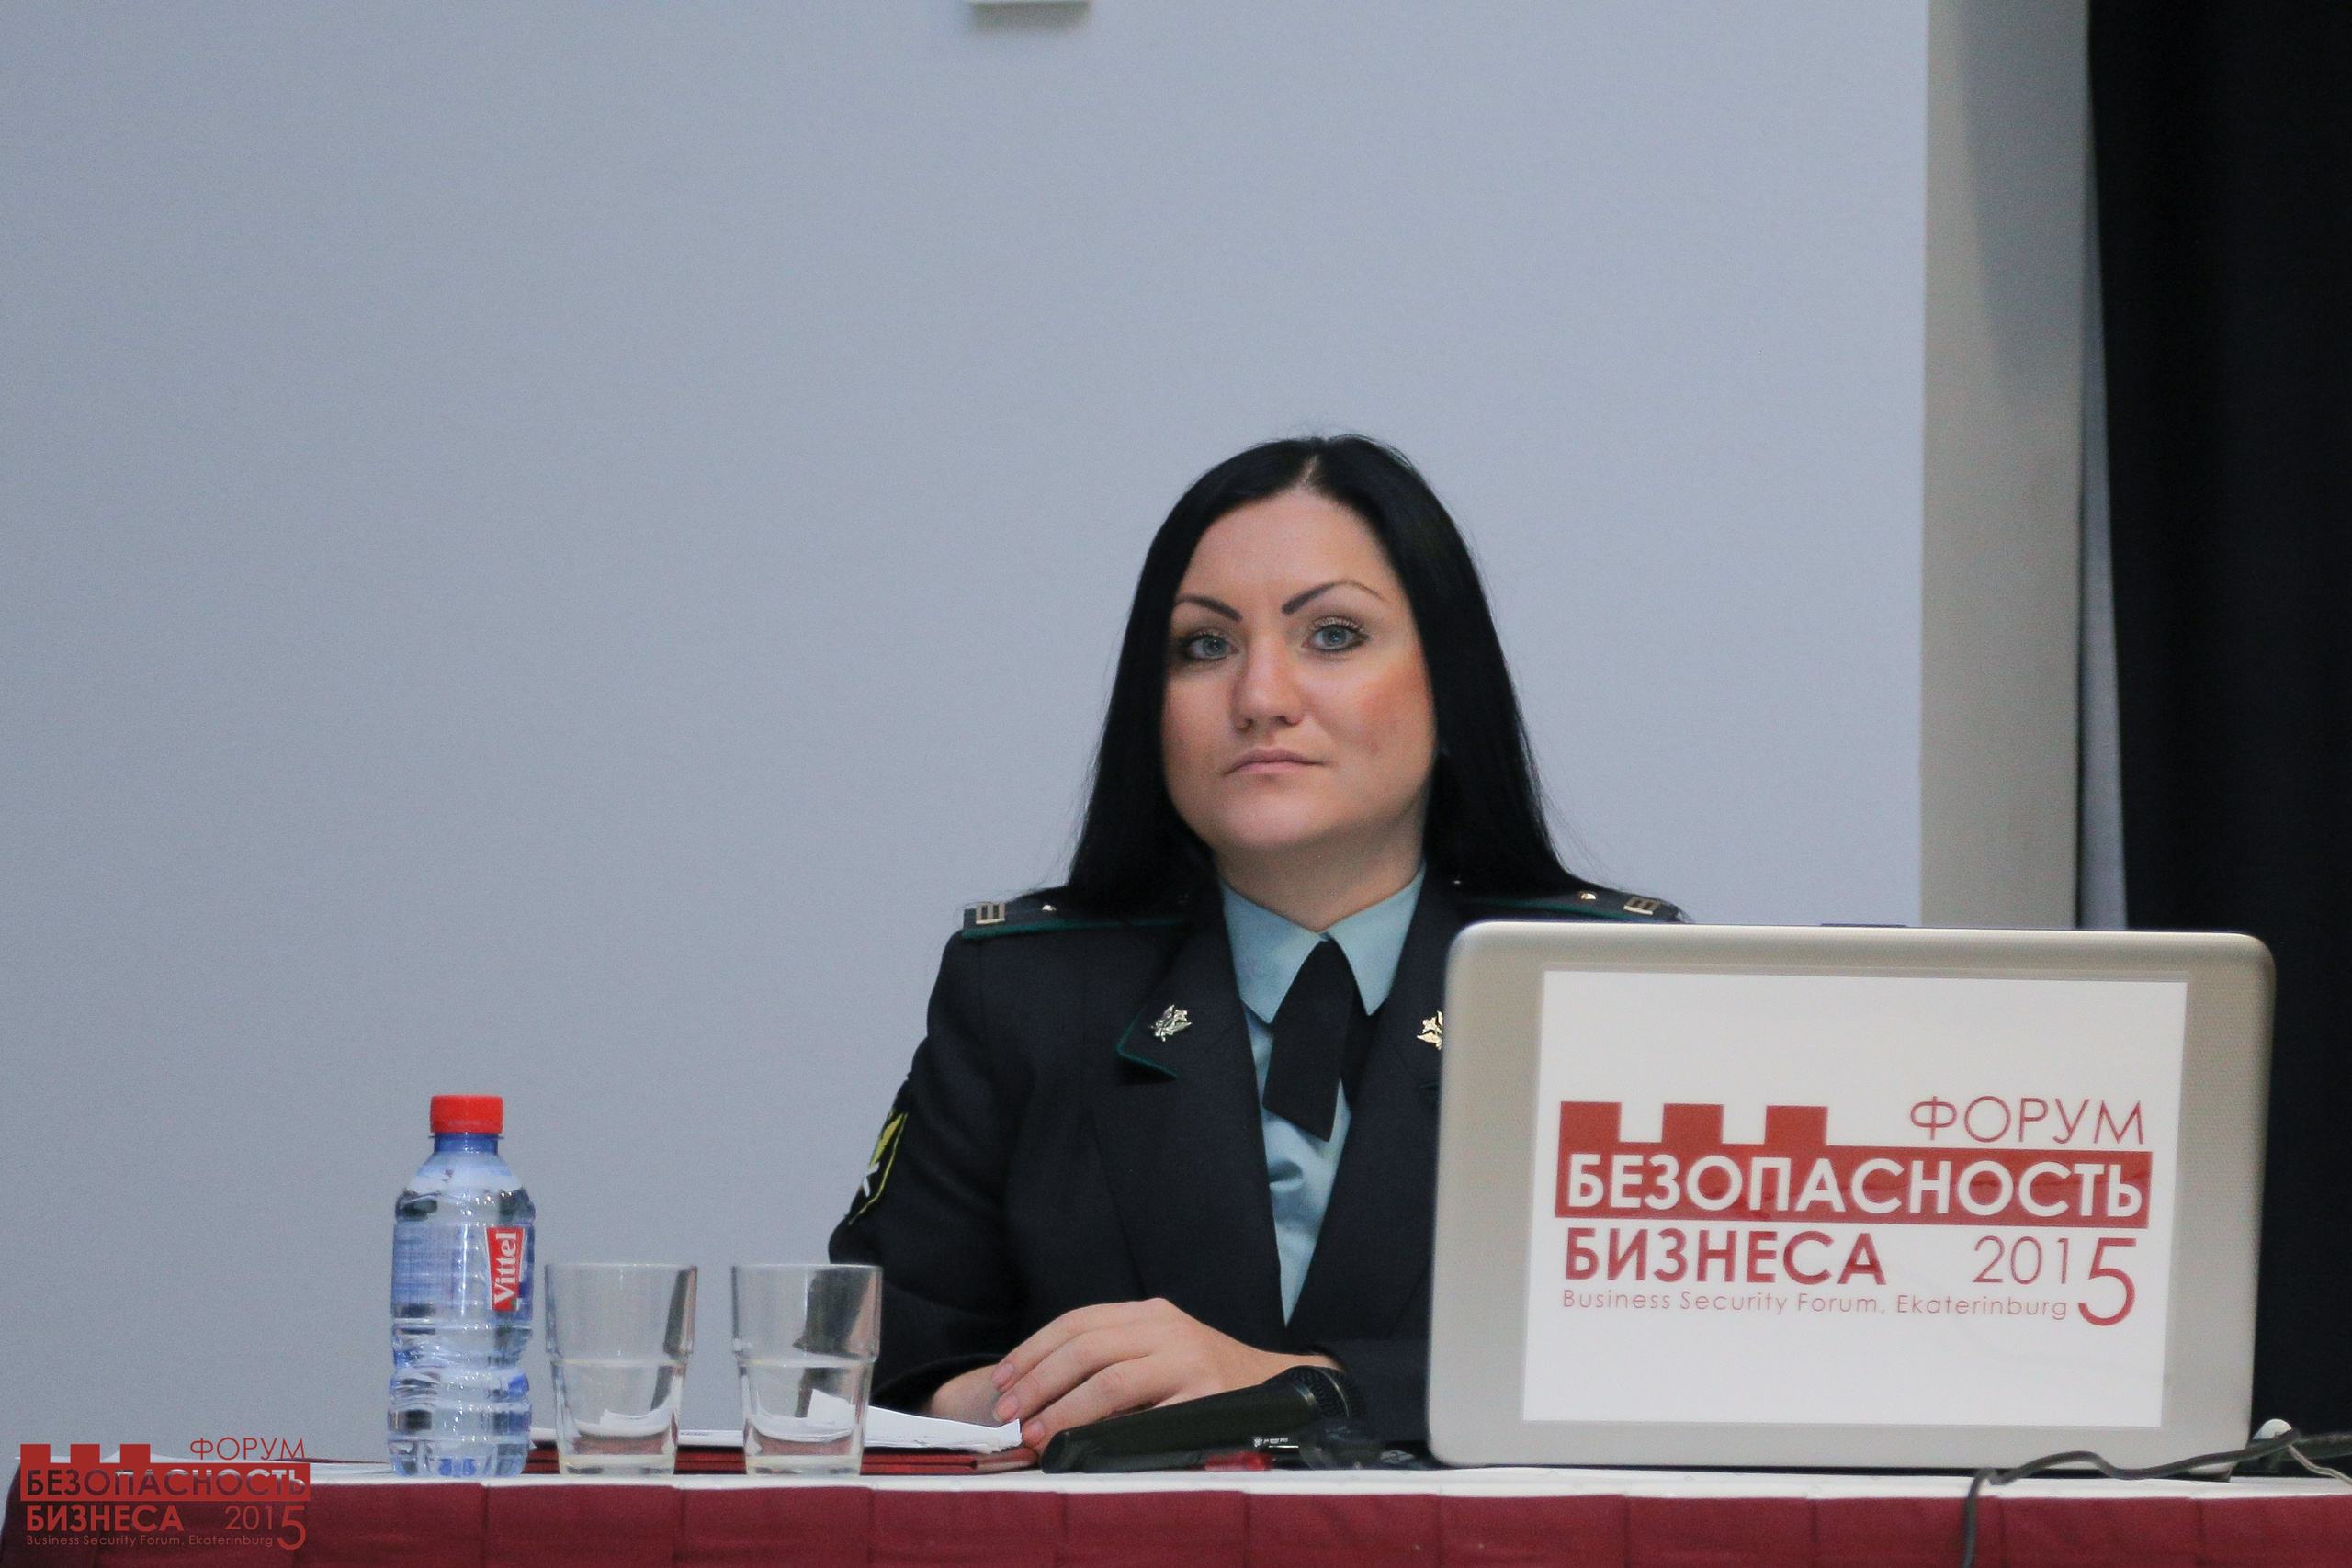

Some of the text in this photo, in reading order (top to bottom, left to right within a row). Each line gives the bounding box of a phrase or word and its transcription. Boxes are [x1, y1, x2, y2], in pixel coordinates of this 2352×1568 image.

[1909, 1095, 2145, 1145] ФОРУМ
[1567, 1153, 2143, 1218] БЕЗОПАСНОСТЬ
[493, 1232, 517, 1304] Vittel
[1565, 1227, 2137, 1326] БИЗНЕСА 2015
[1562, 1289, 2067, 1320] Business Security Forum, Ekaterinburg
